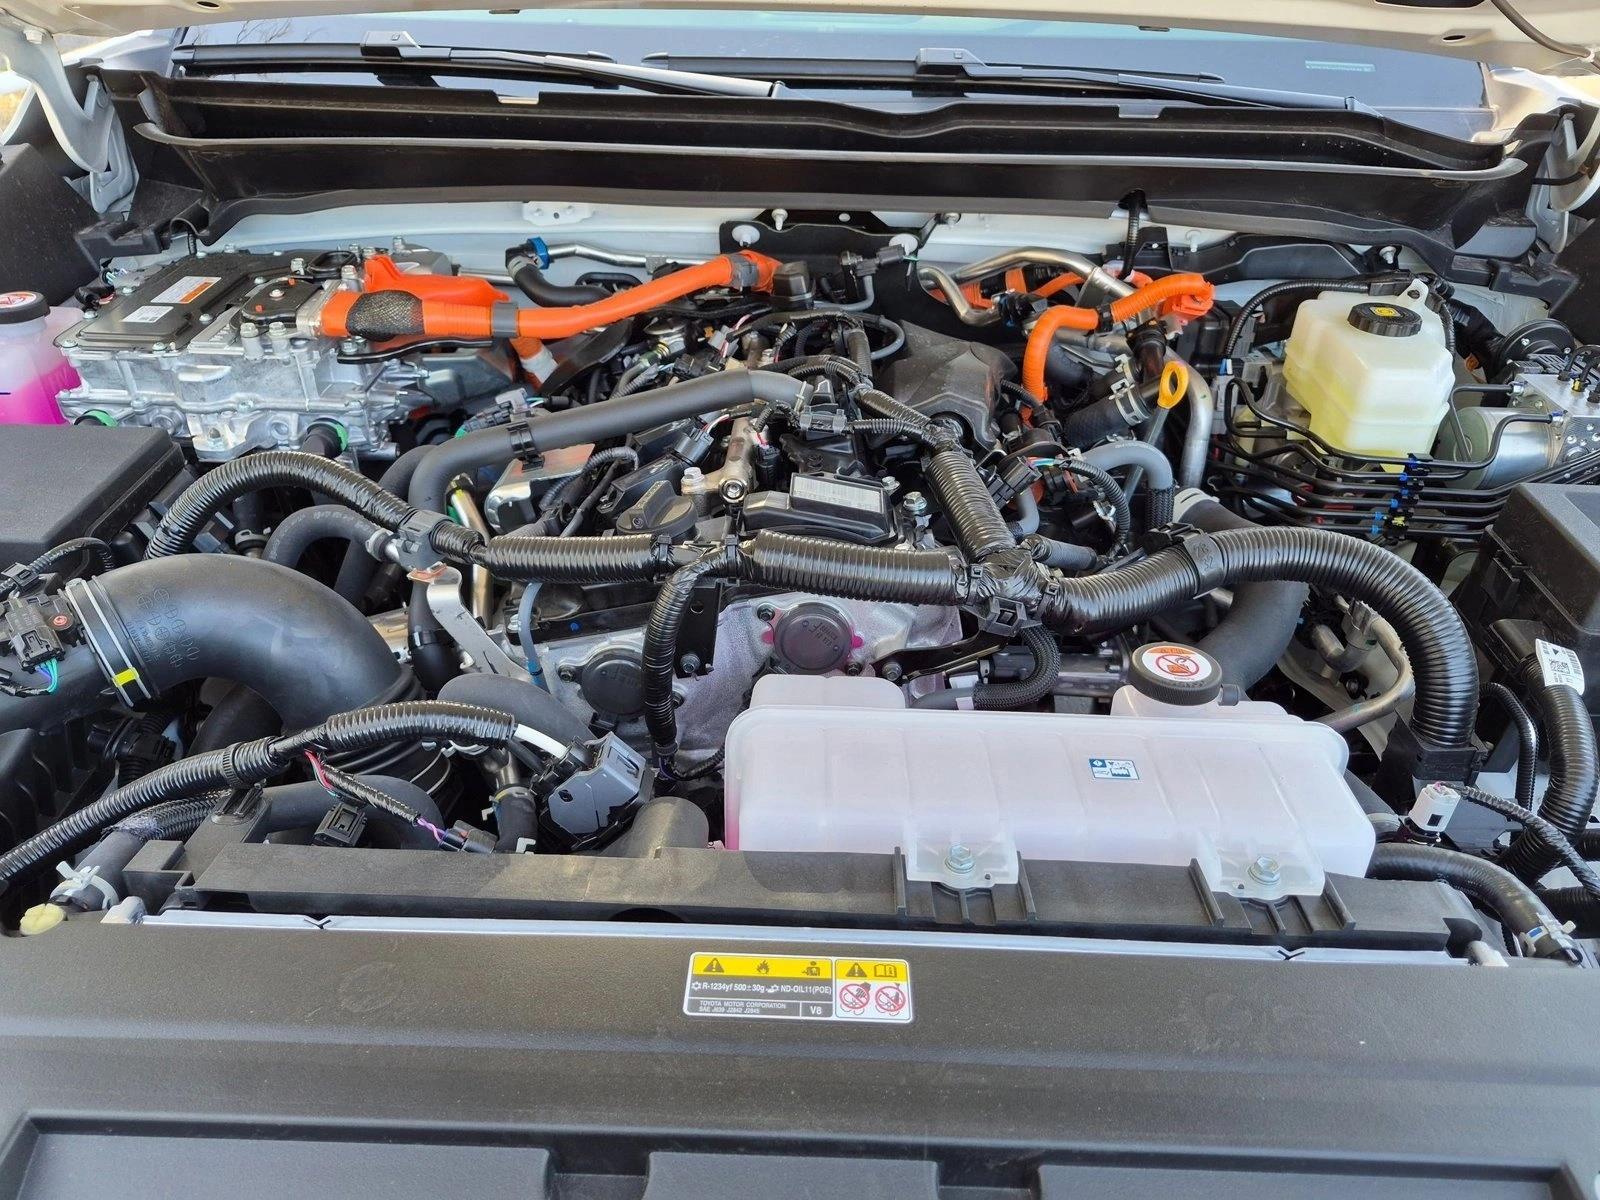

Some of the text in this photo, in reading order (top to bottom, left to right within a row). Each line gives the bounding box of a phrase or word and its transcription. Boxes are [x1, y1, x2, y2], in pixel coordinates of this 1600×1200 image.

[702, 982, 733, 992] R-1234yf
[780, 984, 832, 995] ND-OIL11(POE)
[746, 1001, 787, 1009] CORPORATION
